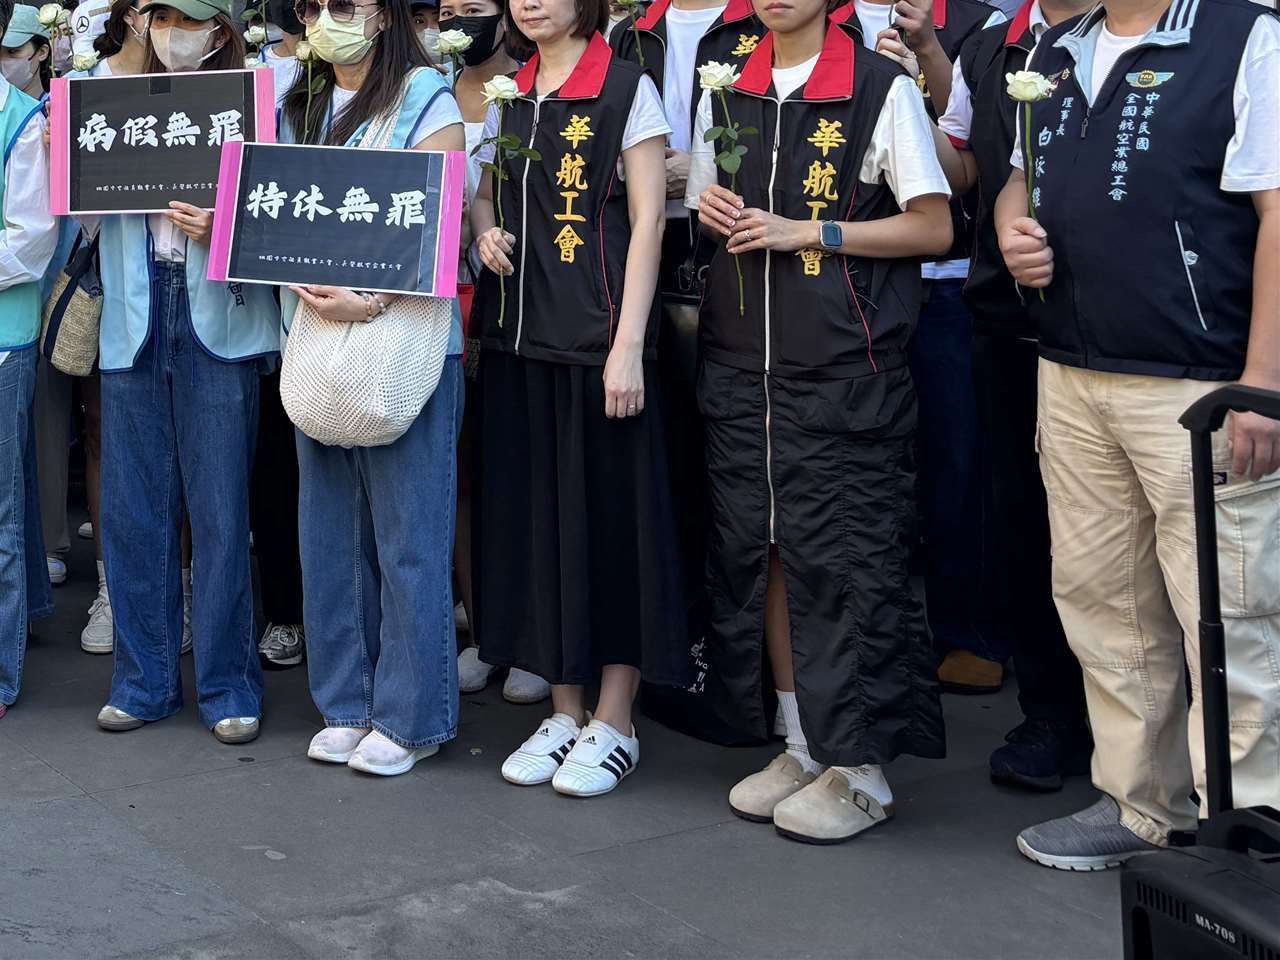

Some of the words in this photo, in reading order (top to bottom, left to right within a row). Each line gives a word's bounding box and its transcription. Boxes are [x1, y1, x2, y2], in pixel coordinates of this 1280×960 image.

[76, 109, 245, 153] 病假無罪
[1135, 91, 1161, 151] 中華民國
[246, 181, 427, 230] 特休無罪
[553, 113, 596, 266] 華航工會
